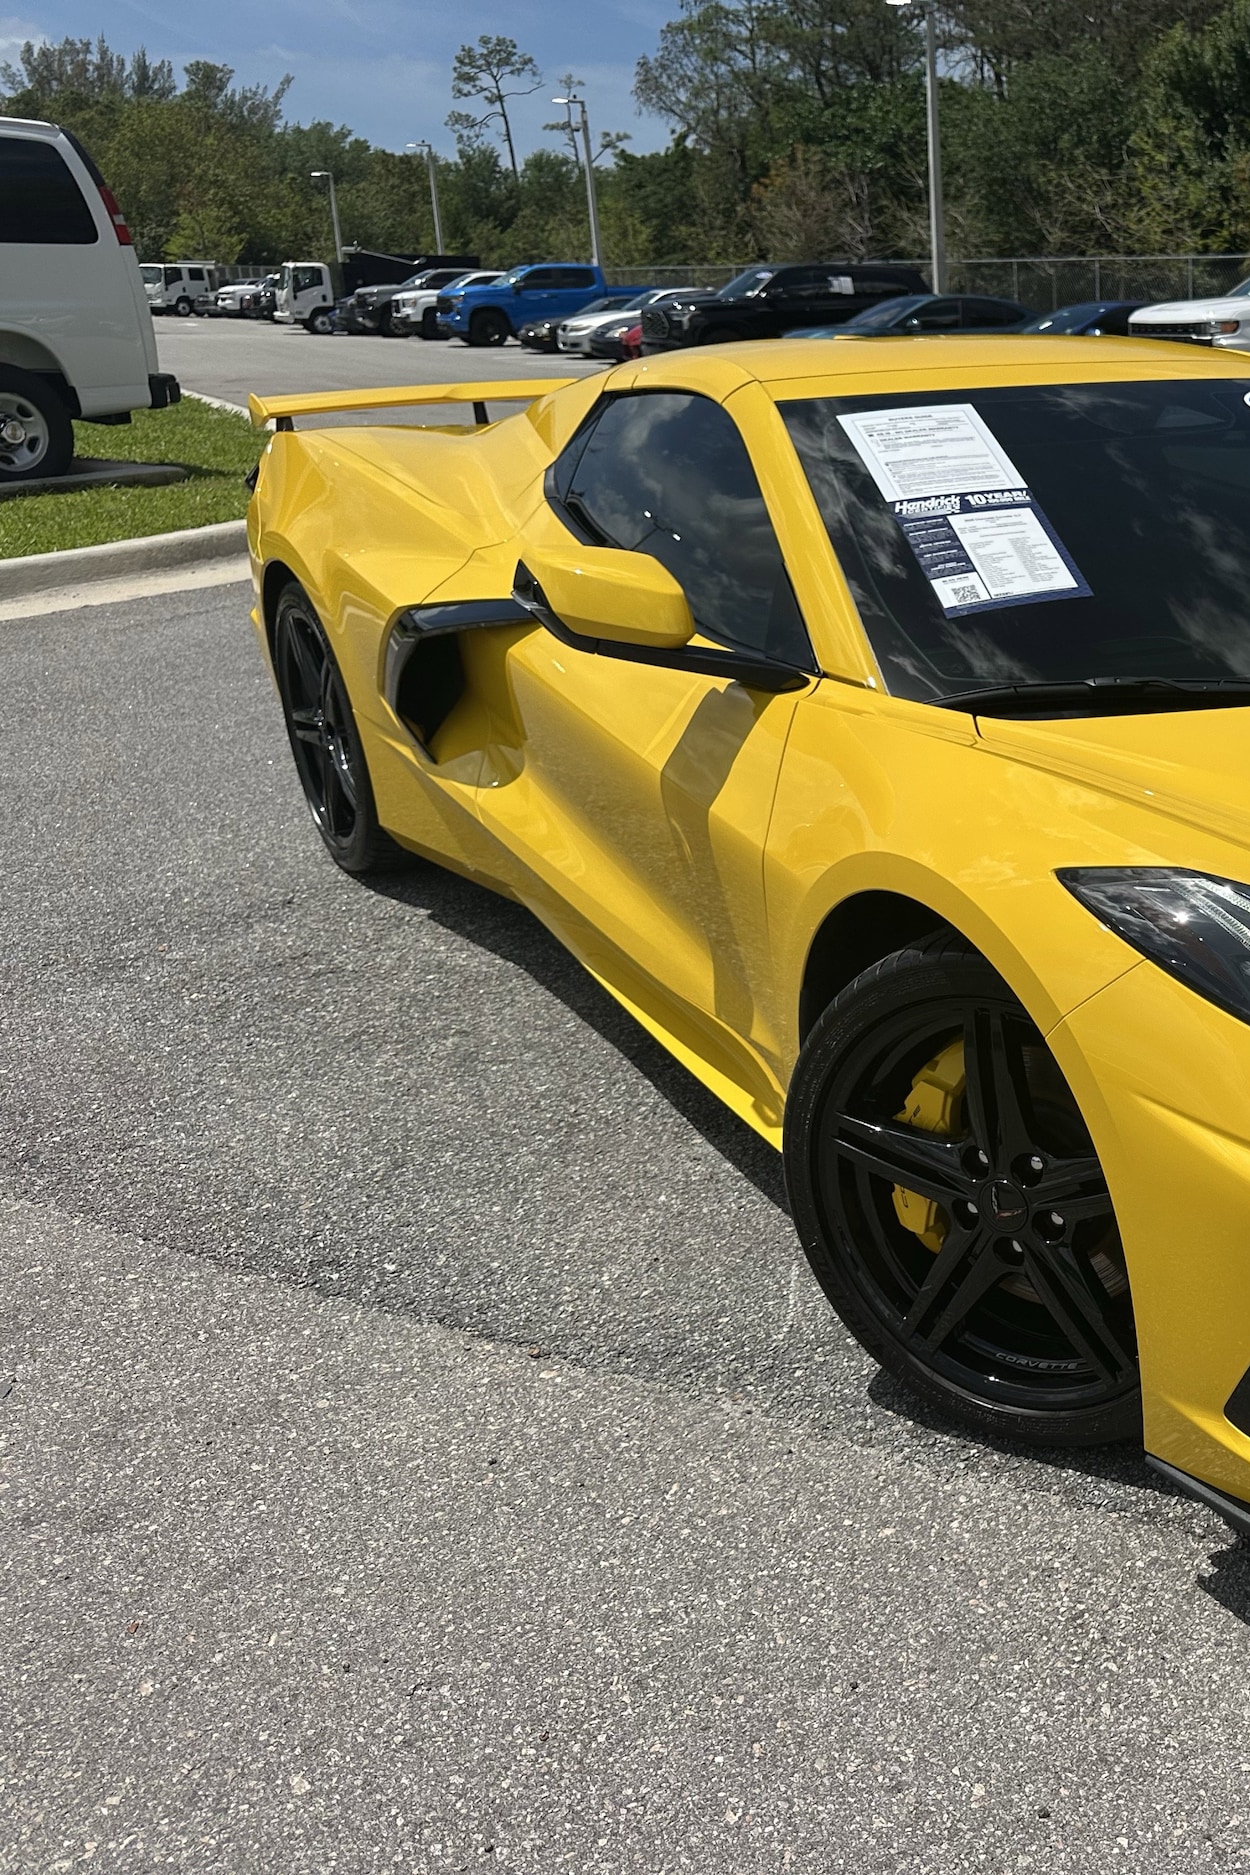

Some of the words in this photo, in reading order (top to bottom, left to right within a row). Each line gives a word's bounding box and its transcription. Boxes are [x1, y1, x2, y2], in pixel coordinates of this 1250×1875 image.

[895, 495, 960, 514] Hendrick
[965, 494, 986, 506] 10
[995, 1352, 1078, 1370] CORVETTE
